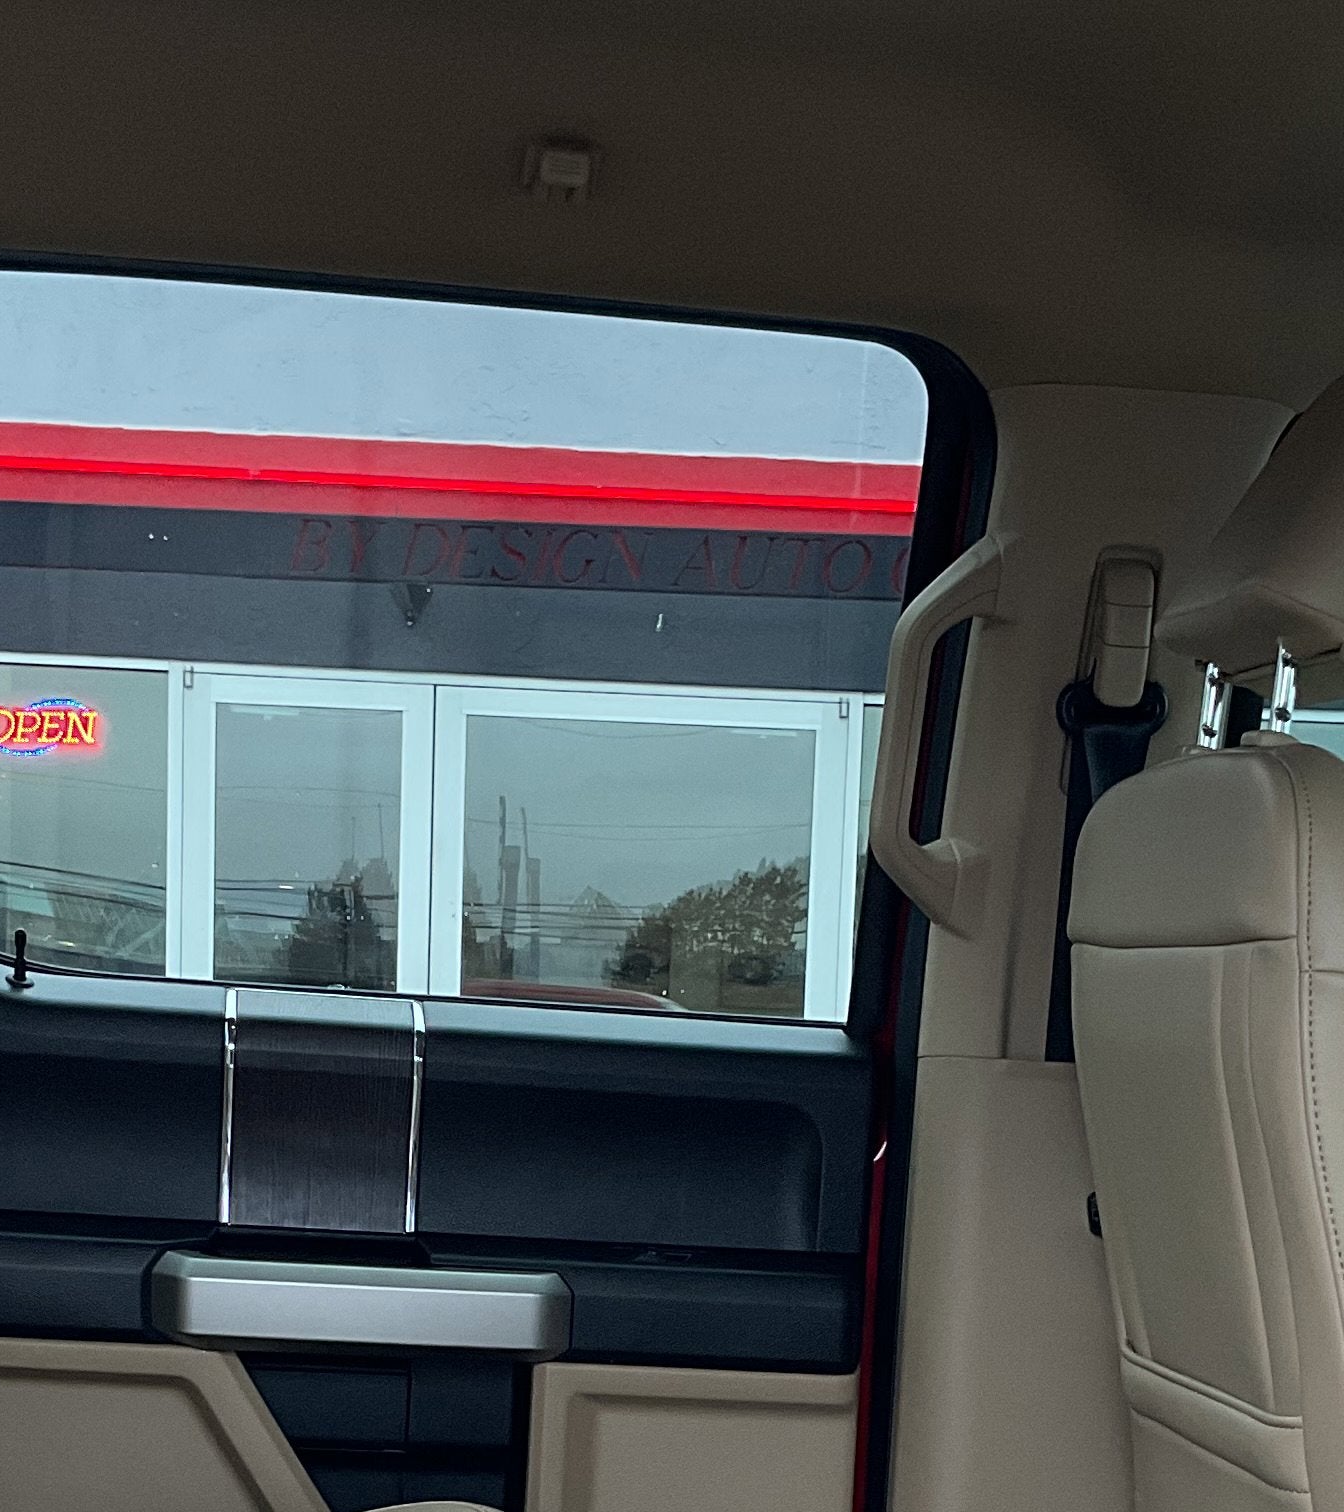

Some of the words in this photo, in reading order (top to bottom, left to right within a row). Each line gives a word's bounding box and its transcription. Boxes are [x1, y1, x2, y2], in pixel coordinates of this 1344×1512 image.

[290, 518, 388, 576] BY
[402, 522, 655, 583] DESIGN
[670, 535, 874, 594] AUTO
